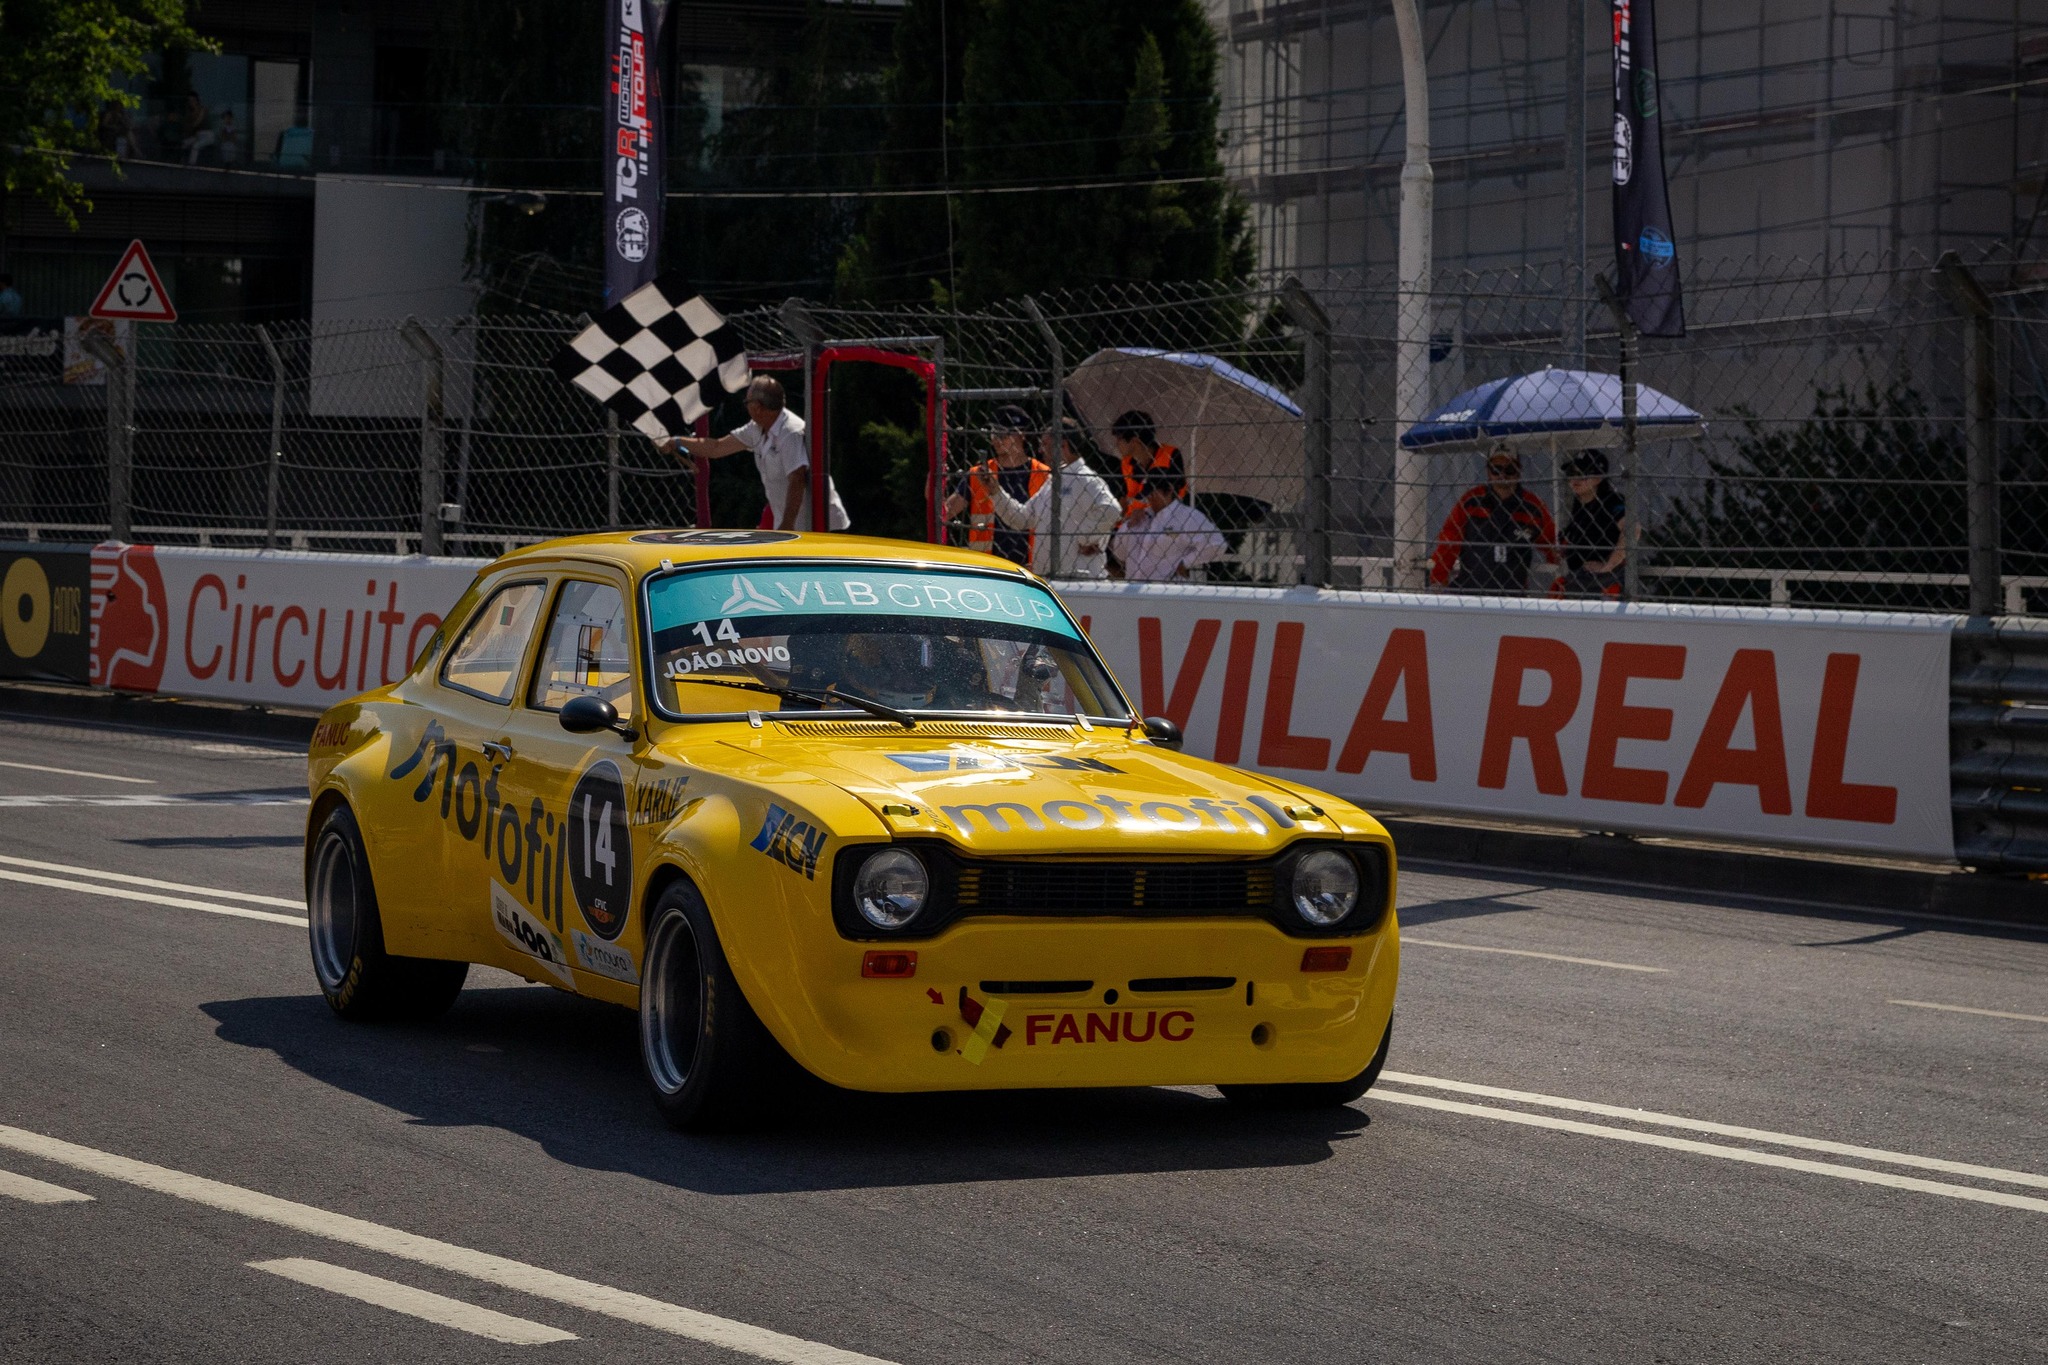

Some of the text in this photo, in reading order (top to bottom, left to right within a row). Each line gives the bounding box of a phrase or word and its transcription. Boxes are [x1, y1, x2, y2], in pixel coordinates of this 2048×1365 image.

[620, 53, 631, 120] WORLD
[632, 39, 645, 113] TOUR
[615, 127, 638, 202] TCR
[624, 212, 644, 258] FIA
[775, 579, 1055, 621] VLB GROUP
[692, 619, 741, 646] 14
[663, 644, 791, 680] JOÃO NOVO
[313, 720, 351, 748] FANUC
[1137, 616, 1898, 826] VILA REAL
[389, 718, 567, 934] motofil
[583, 793, 616, 887] 14
[938, 794, 1297, 840] motofil
[594, 947, 628, 972] moura
[1026, 1010, 1195, 1046] FANUC
